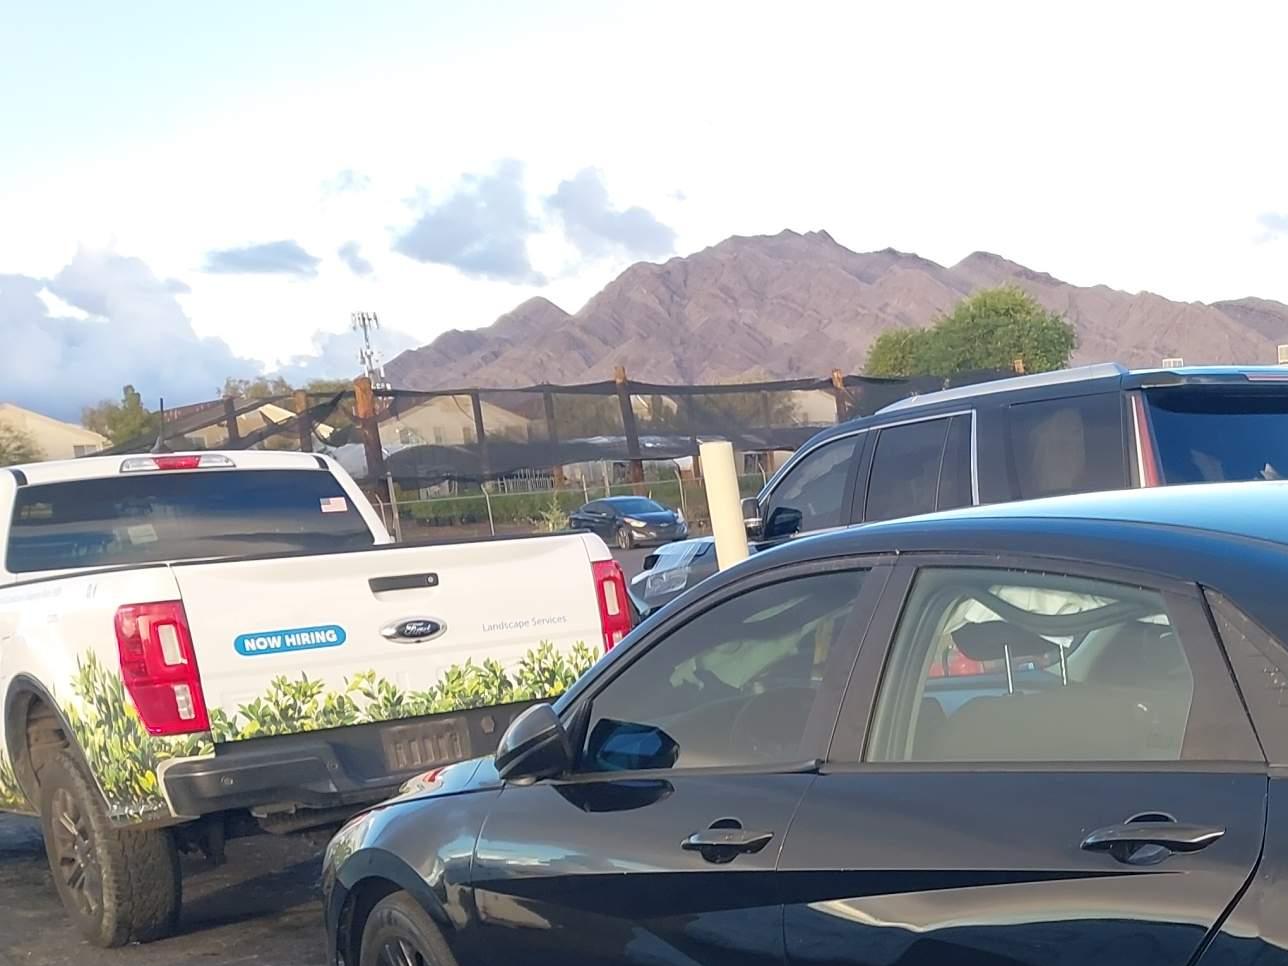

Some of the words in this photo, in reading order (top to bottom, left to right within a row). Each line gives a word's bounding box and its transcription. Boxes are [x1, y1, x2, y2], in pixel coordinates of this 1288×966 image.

[482, 620, 530, 632] Landscape
[531, 615, 567, 626] Services
[244, 635, 281, 651] NOW
[285, 630, 337, 646] HIRING
